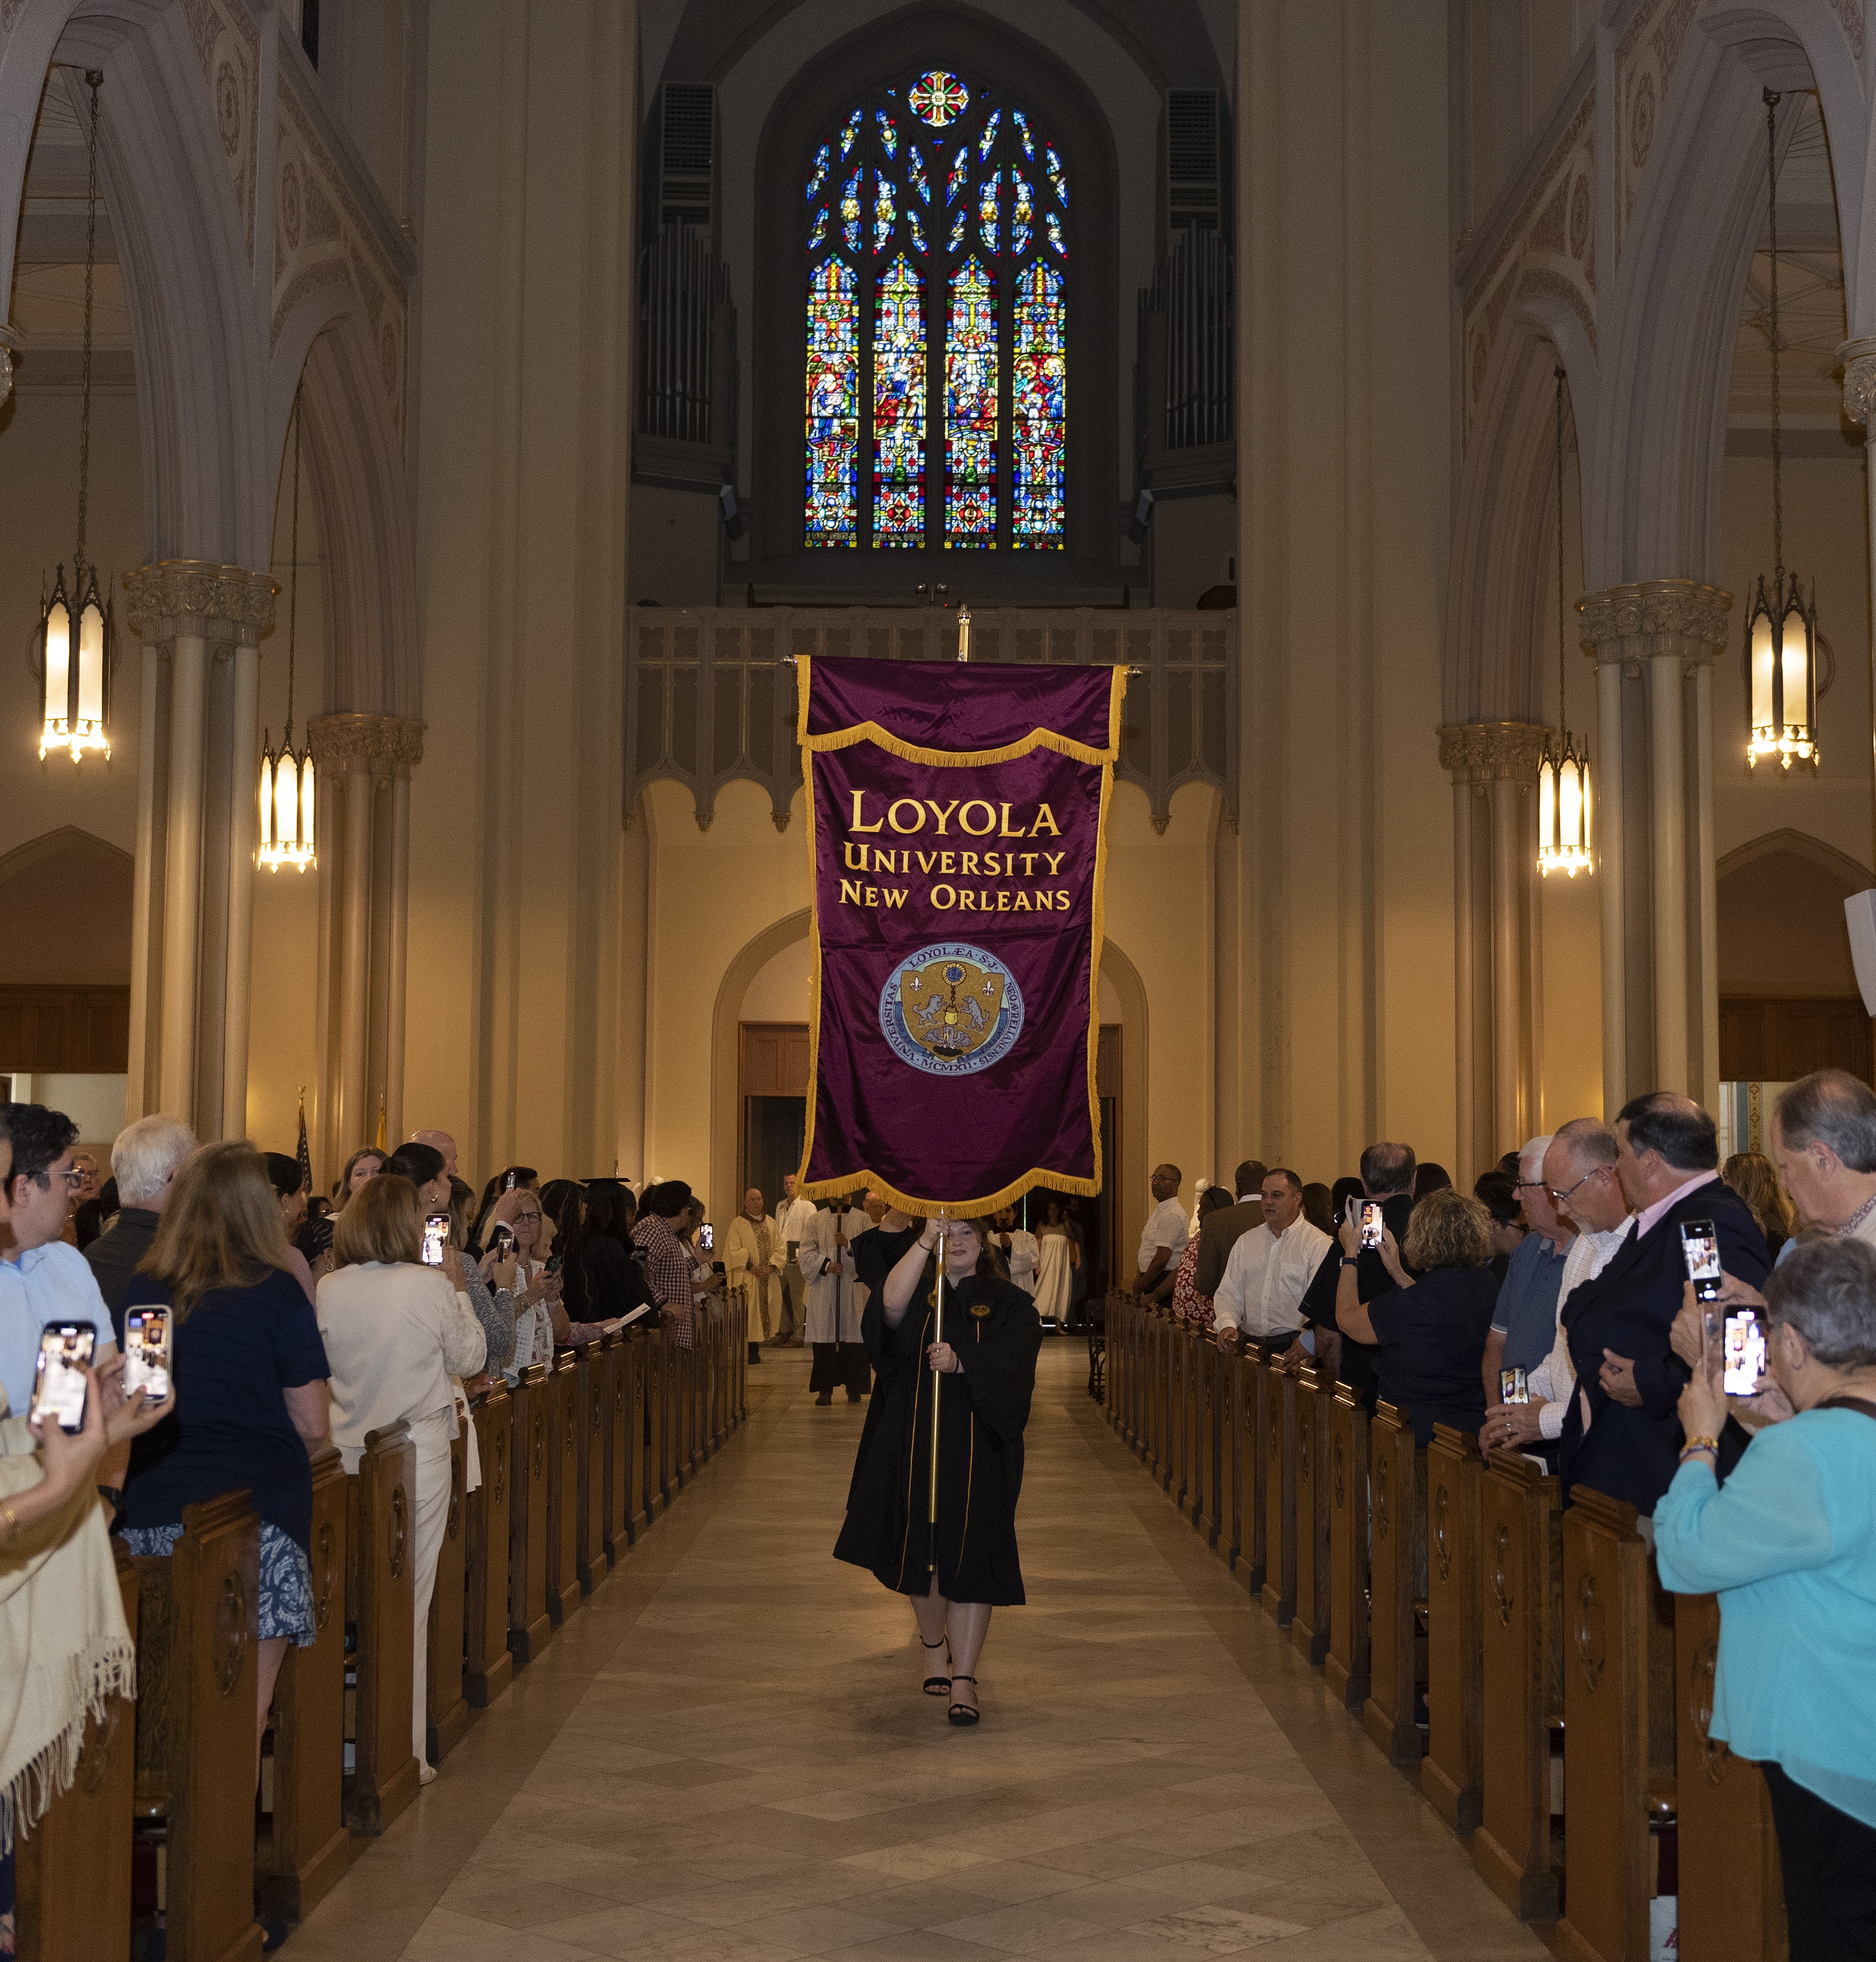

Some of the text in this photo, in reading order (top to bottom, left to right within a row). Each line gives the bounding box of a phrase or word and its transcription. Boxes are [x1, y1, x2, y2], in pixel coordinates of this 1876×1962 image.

[849, 790, 1061, 837] LOYOLA
[843, 841, 1065, 876] UNIVERSITY
[839, 879, 1071, 911] NEW ORLEANS
